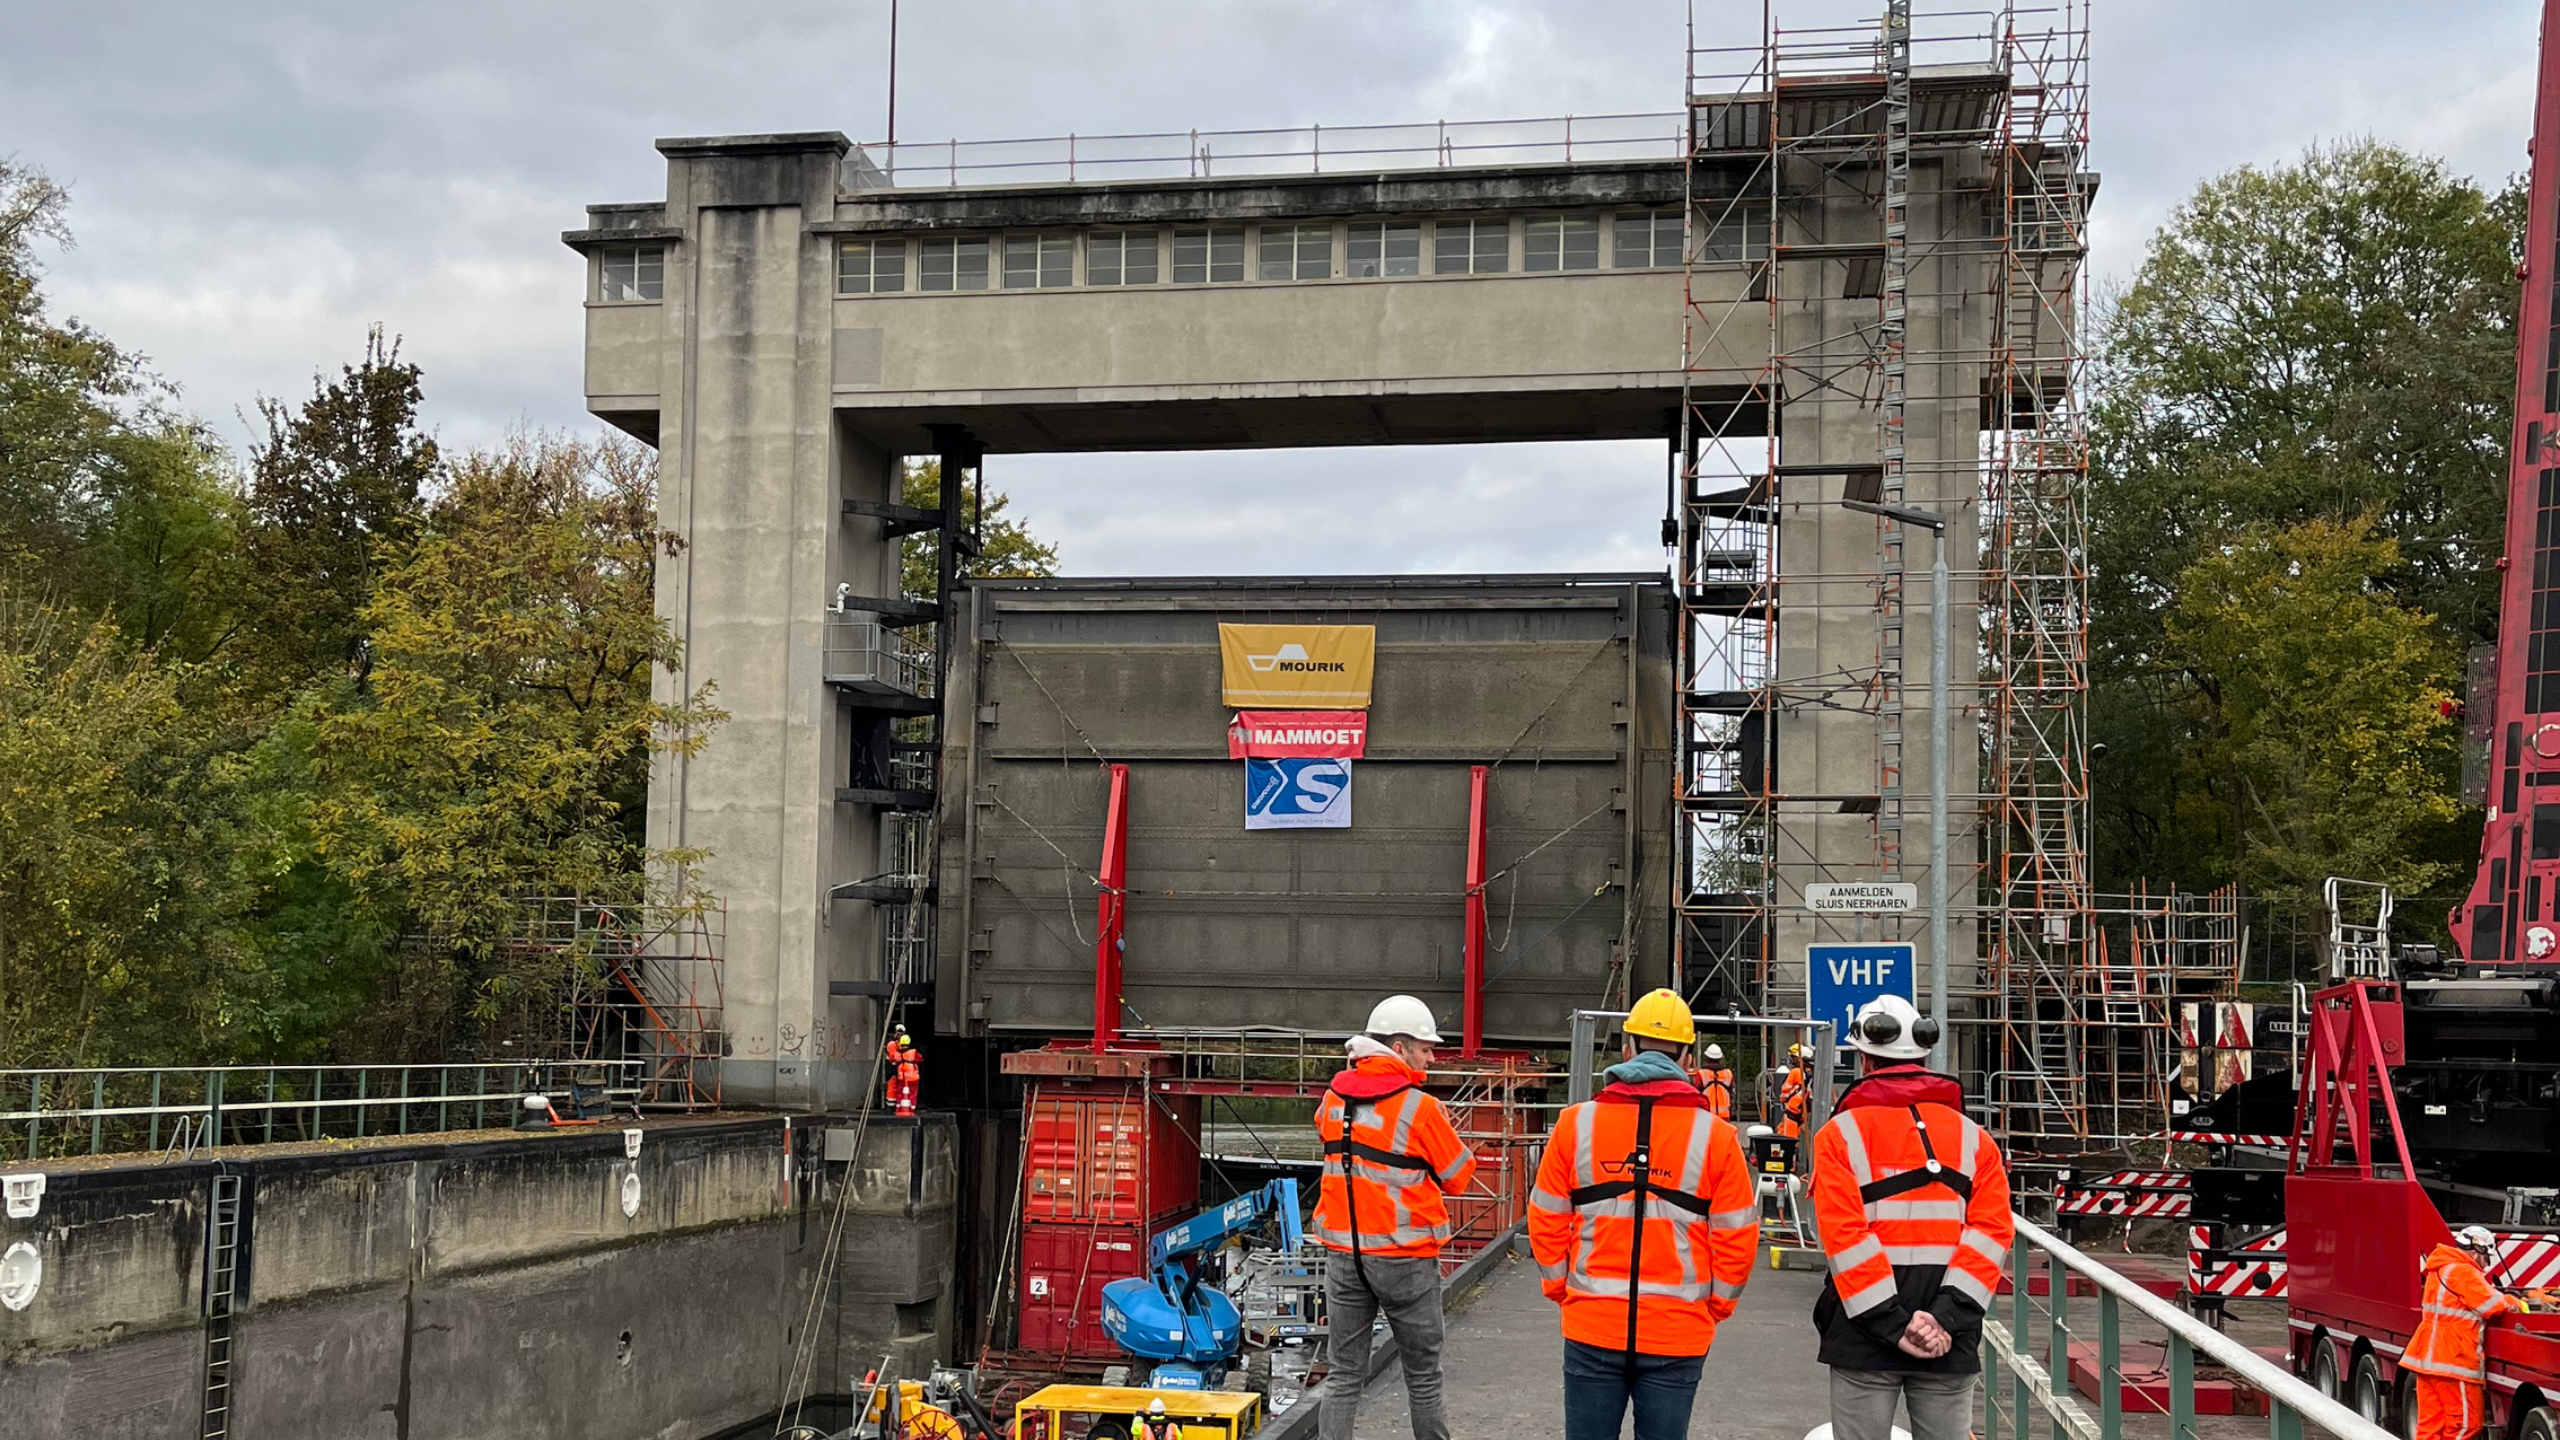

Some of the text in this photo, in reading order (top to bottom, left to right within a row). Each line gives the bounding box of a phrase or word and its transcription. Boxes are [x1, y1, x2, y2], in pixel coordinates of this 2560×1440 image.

[1279, 661, 1345, 672] MOURIK
[1255, 729, 1363, 745] MAMMOET
[1829, 887, 1894, 897] AANMELDEN
[1815, 899, 1908, 909] SLUIS NEERHAREN
[1827, 958, 1895, 986] VHF
[1627, 1167, 1673, 1178] MRIK
[1035, 1281, 1043, 1292] 2
